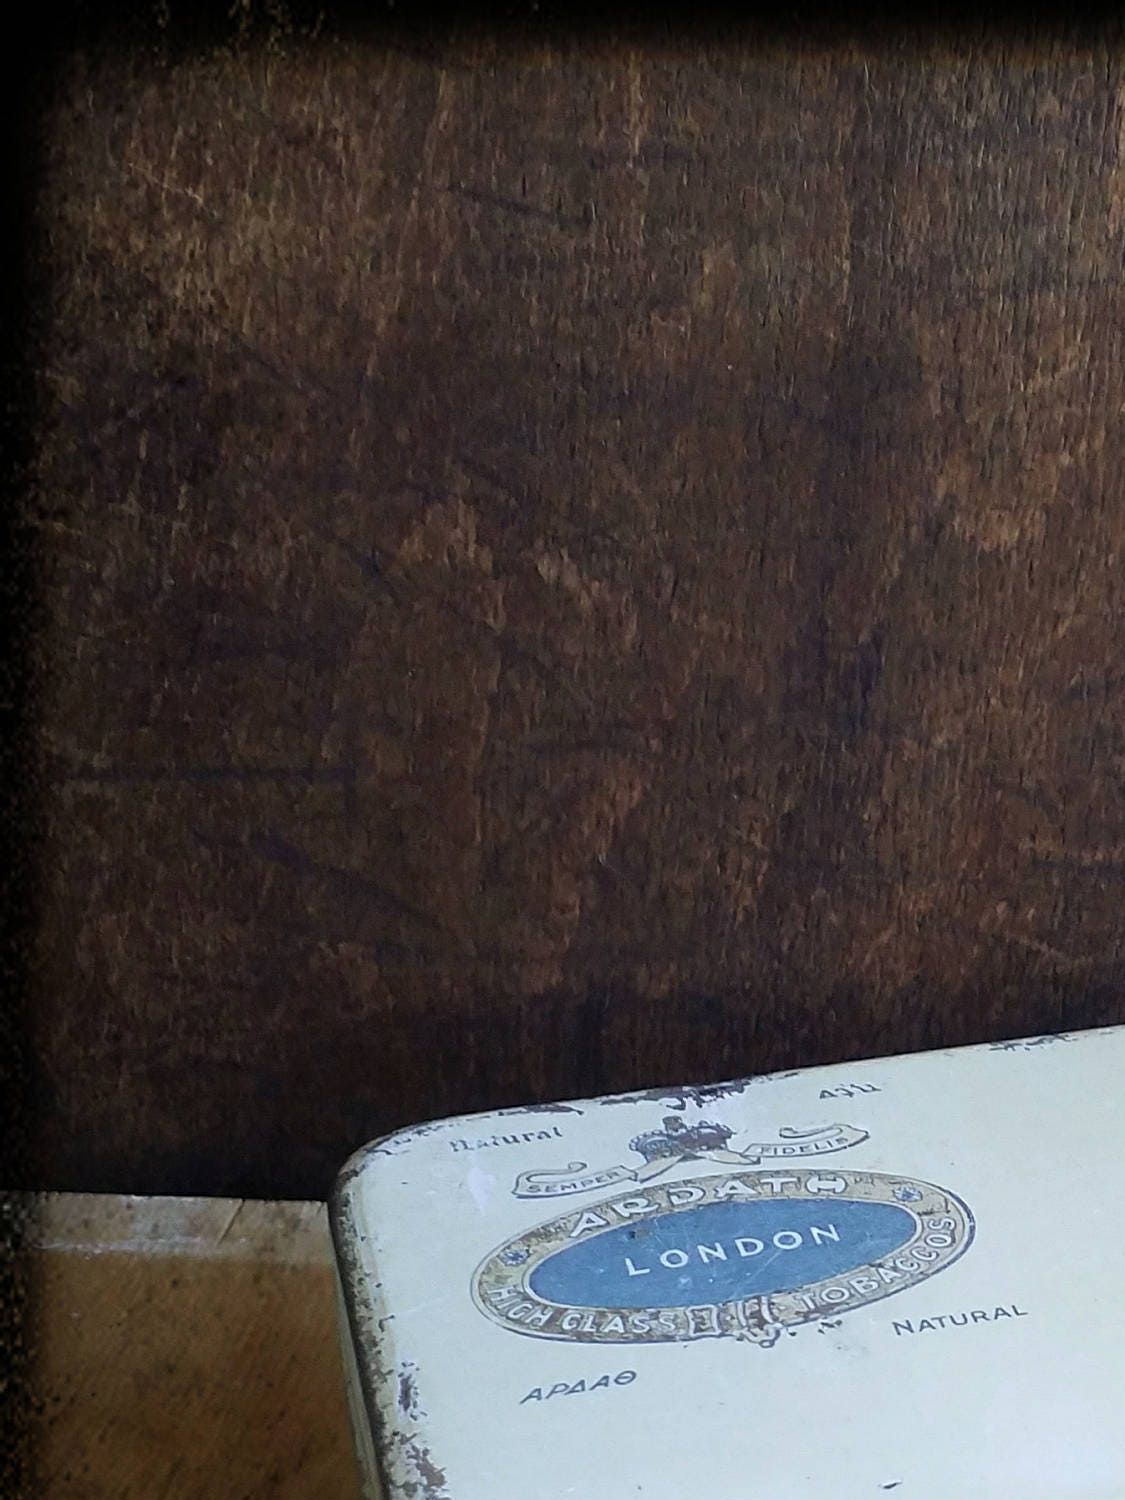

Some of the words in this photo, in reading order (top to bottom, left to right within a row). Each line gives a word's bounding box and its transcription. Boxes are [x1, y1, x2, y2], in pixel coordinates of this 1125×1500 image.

[526, 1171, 620, 1193] SEMPER
[760, 1135, 848, 1156] FIDELIS
[569, 1174, 848, 1237] ARDATH
[487, 1286, 555, 1327] HIGH
[561, 1309, 677, 1334] CLASS
[796, 1216, 957, 1310] TOBACCOS
[624, 1223, 841, 1276] LONDON
[892, 1304, 1028, 1336] NATURAL
